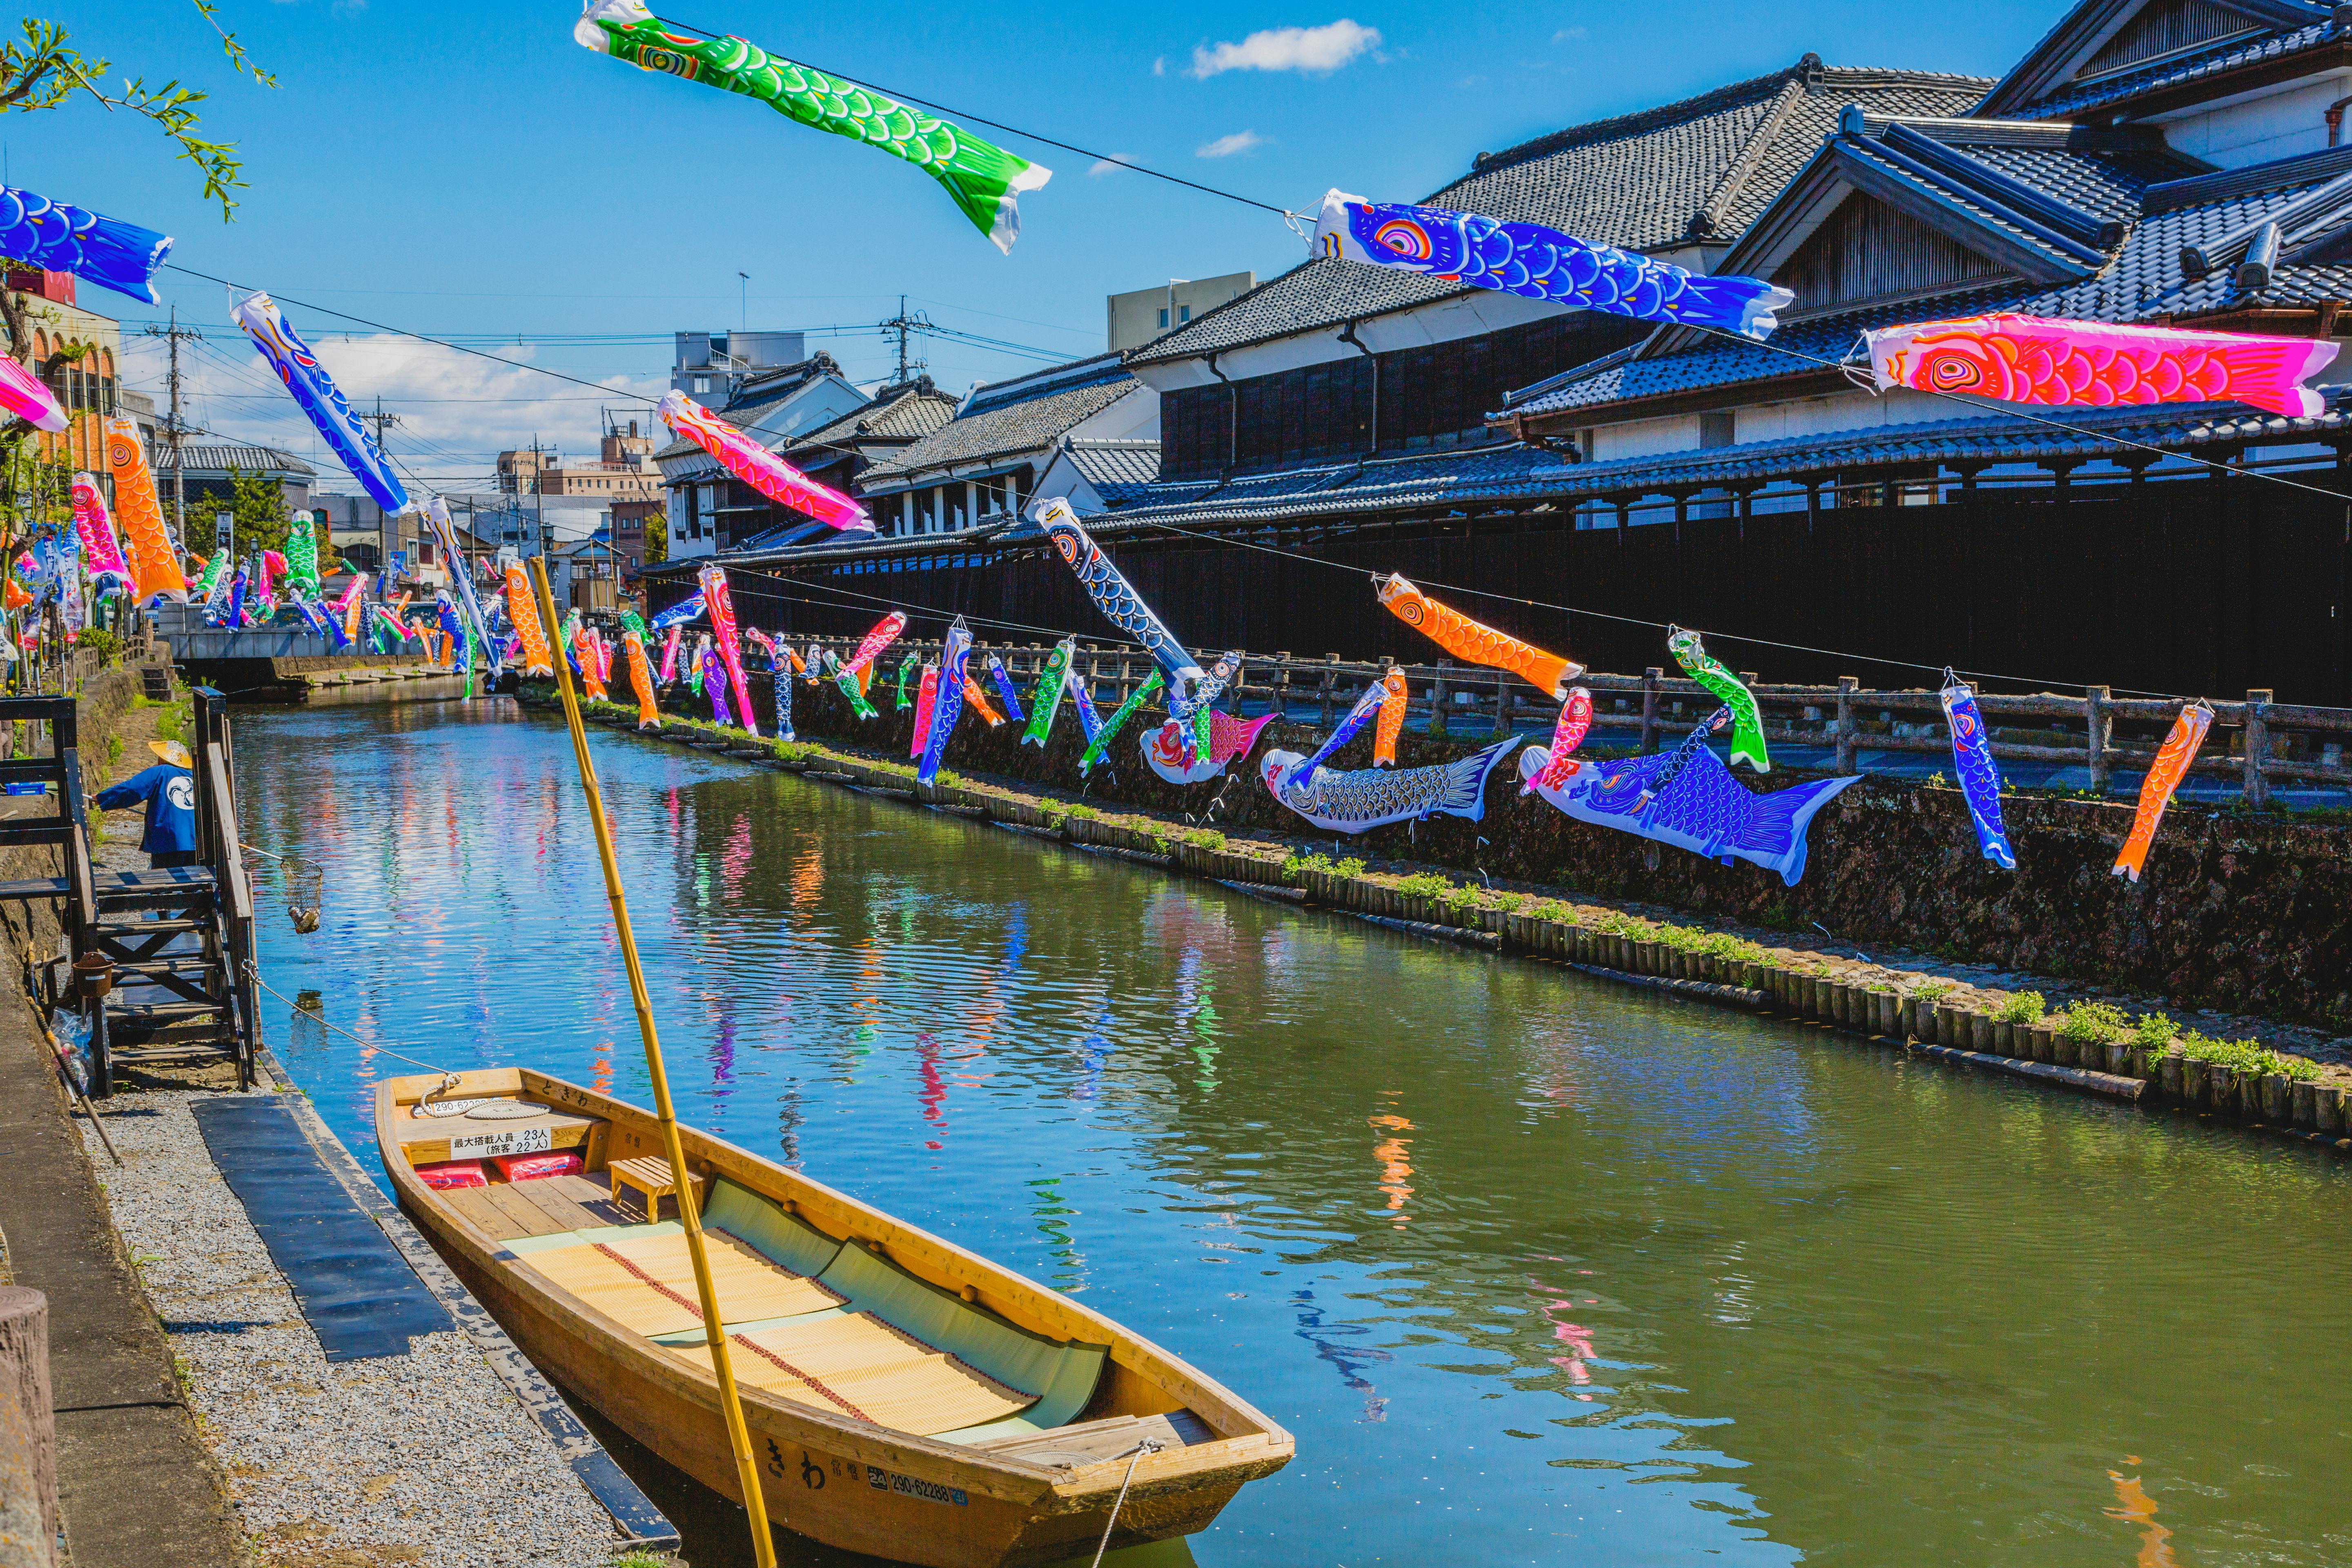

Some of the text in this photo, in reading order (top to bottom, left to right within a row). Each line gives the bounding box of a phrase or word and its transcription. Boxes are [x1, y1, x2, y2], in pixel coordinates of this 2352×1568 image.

[542, 1080, 588, 1107] ときわ
[454, 1129, 548, 1148] 最大搭載人員 23人
[767, 1438, 825, 1489] きわ
